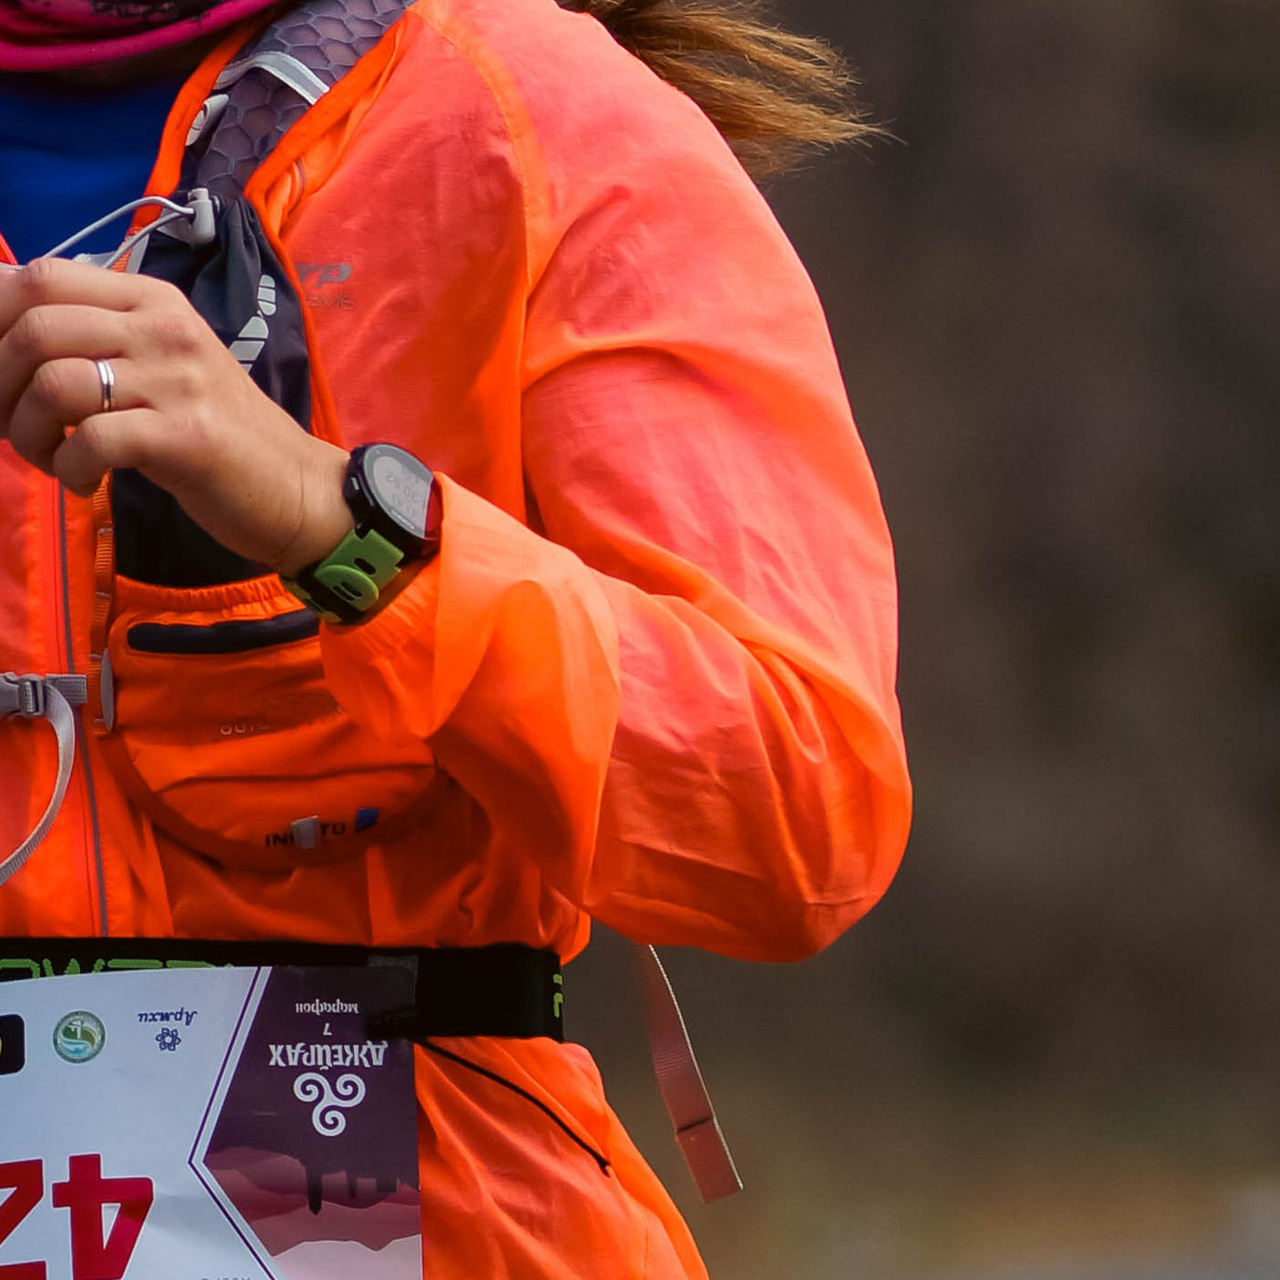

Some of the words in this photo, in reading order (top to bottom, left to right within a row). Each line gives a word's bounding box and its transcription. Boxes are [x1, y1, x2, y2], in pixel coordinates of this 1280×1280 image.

[295, 998, 359, 1016] марафон
[137, 1007, 198, 1026] Армхи
[323, 1023, 332, 1036] 7
[268, 1040, 389, 1070] ДЖЕЙРАХ
